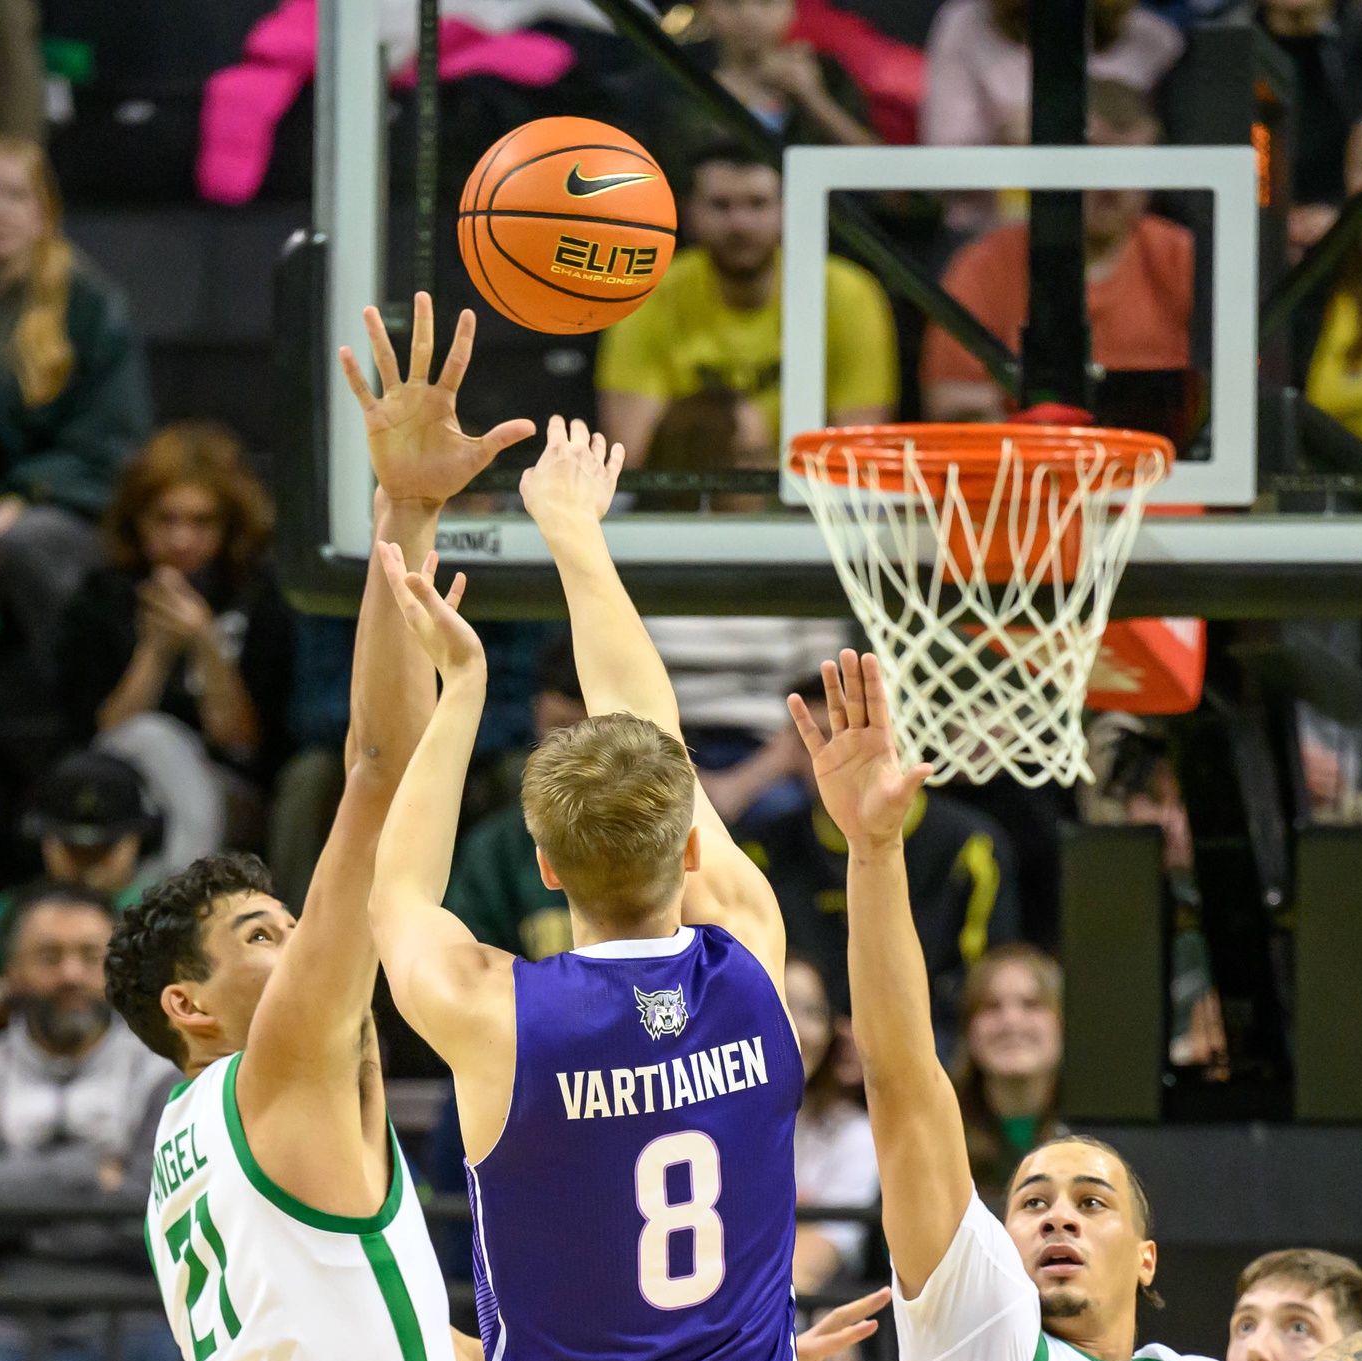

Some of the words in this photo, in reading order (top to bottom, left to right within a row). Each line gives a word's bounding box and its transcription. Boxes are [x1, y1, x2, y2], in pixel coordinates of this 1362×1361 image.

[553, 234, 658, 277] ELITE
[556, 1036, 768, 1122] VARTIAINEN
[634, 1129, 727, 1312] 8
